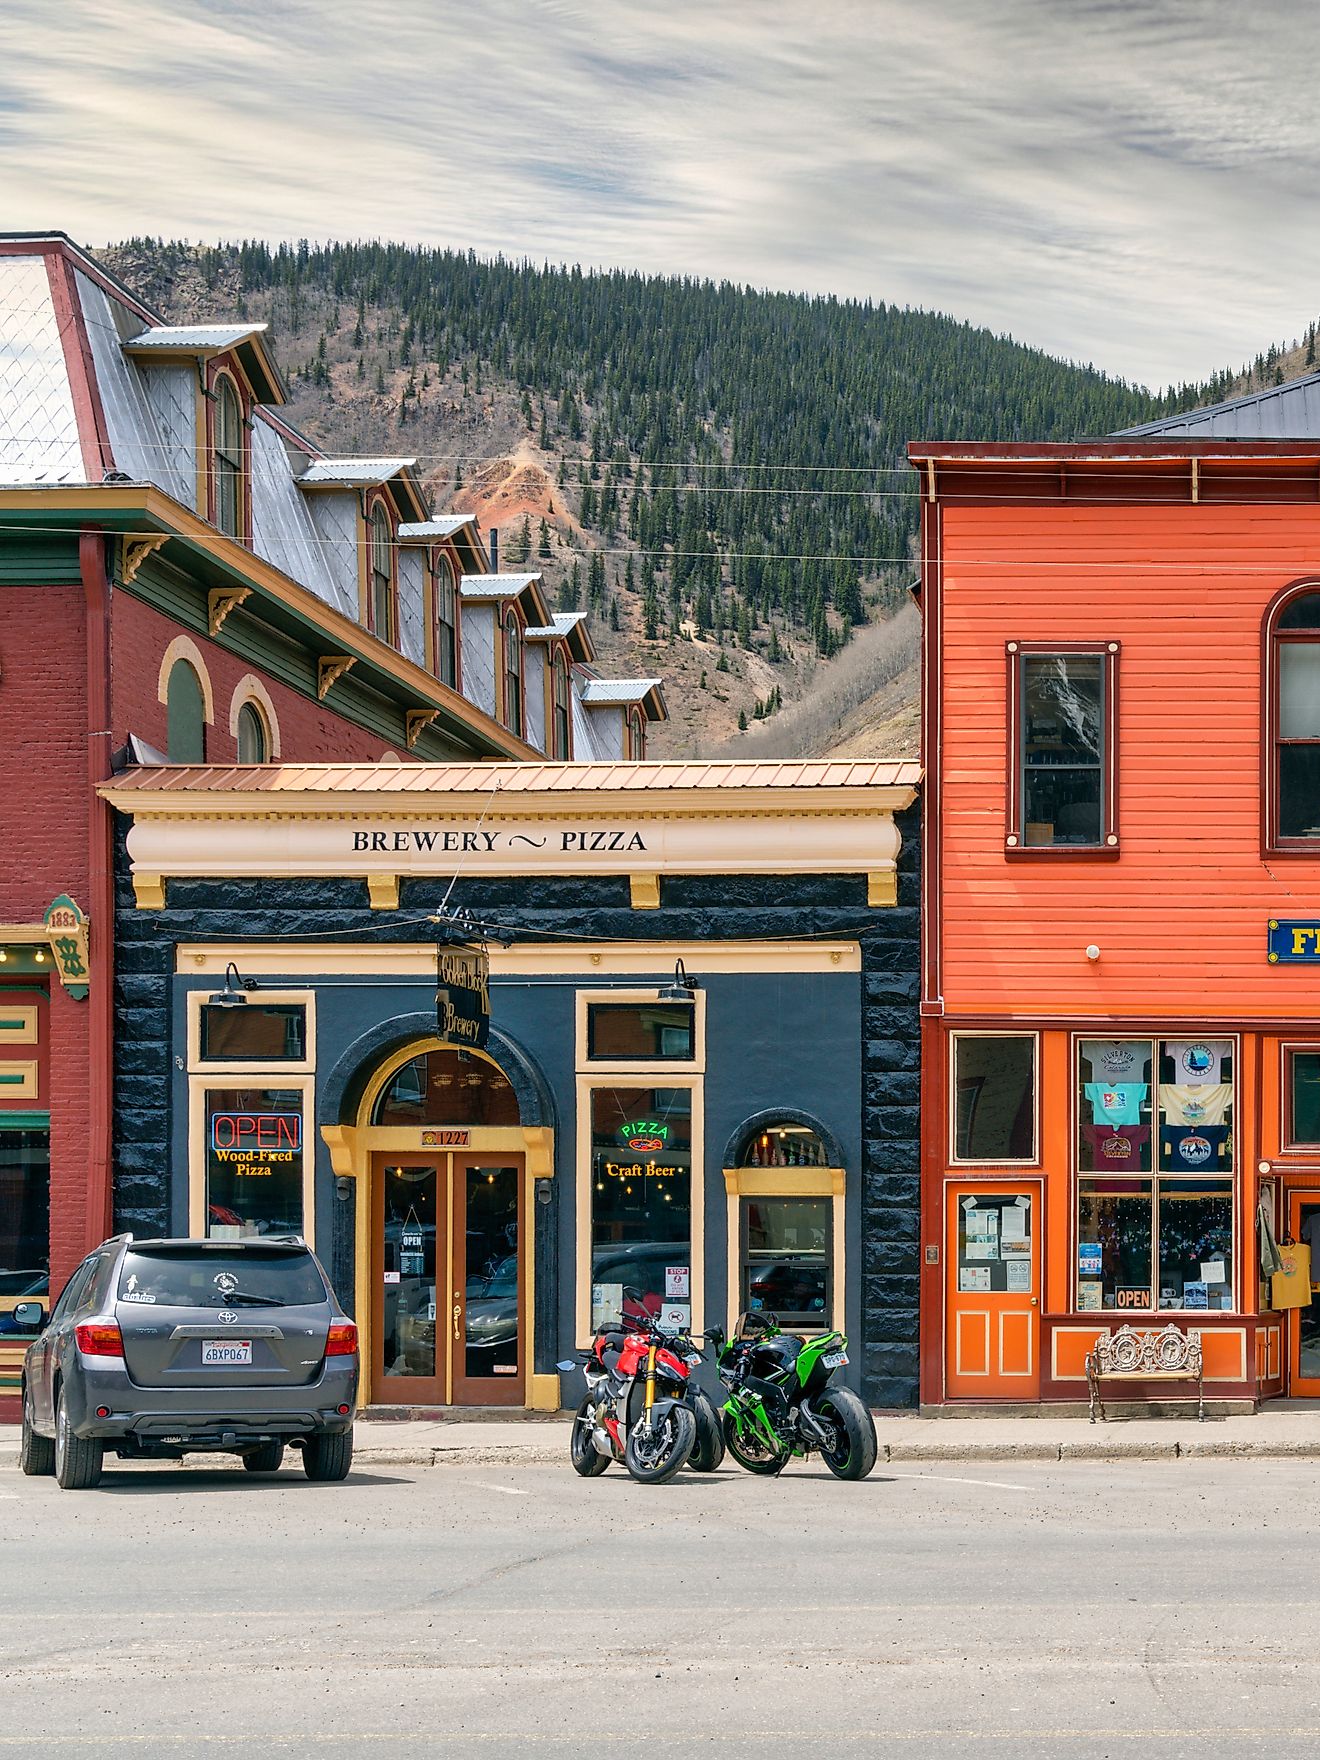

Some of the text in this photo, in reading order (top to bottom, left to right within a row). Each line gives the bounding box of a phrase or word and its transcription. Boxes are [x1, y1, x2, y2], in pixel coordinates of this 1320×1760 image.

[352, 831, 648, 851] BREWERY PIZZA
[448, 1003, 480, 1042] Brewery
[1100, 1050, 1136, 1064] SILVERTON
[215, 1116, 298, 1148] OPEN
[440, 1130, 468, 1145] 1227
[621, 1122, 669, 1140] PIZZA
[215, 1149, 294, 1162] Wood-Fired
[235, 1163, 272, 1176] Pizza
[607, 1163, 676, 1177] Craft Beer
[403, 1236, 422, 1246] OPEN
[1117, 1290, 1150, 1307] OPEN
[205, 1348, 249, 1360] 6BXP067
